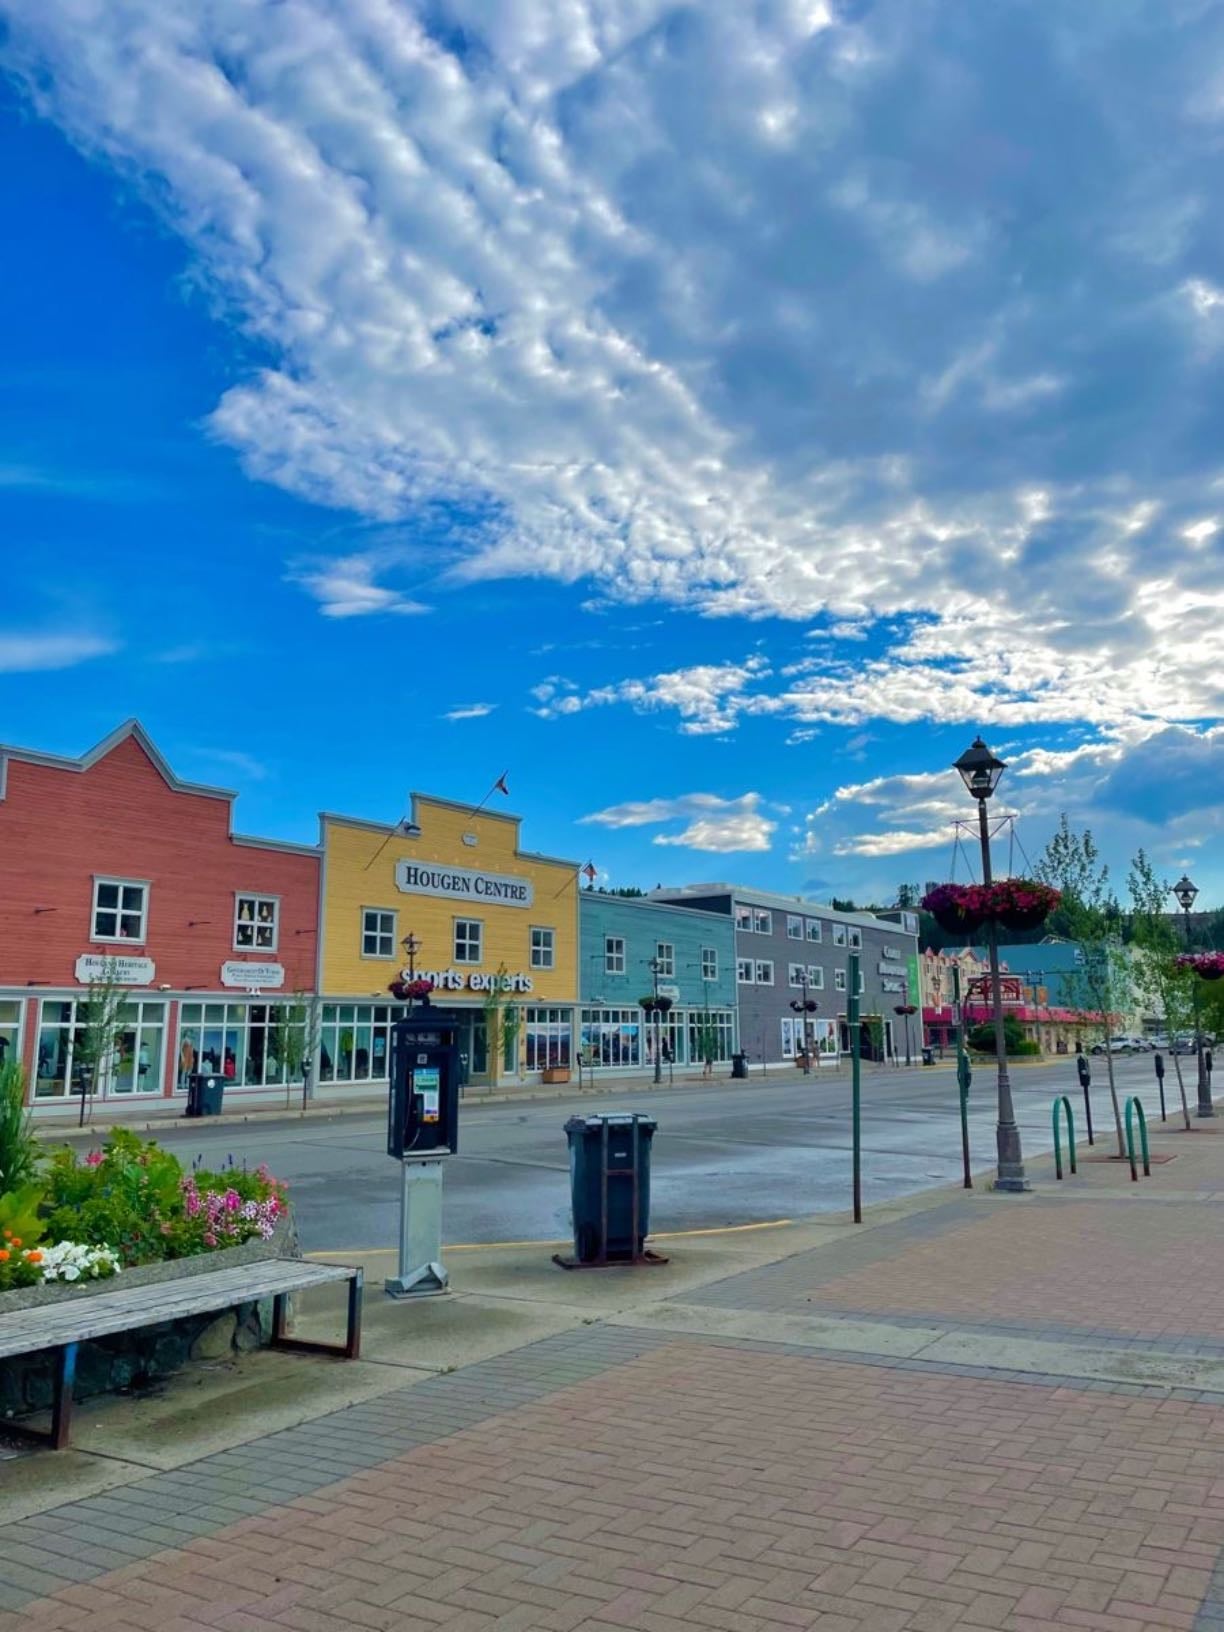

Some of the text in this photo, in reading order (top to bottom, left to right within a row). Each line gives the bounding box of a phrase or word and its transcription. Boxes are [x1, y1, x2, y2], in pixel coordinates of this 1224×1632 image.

[405, 866, 527, 901] HOUGEN CENTRE
[470, 973, 533, 996] experts
